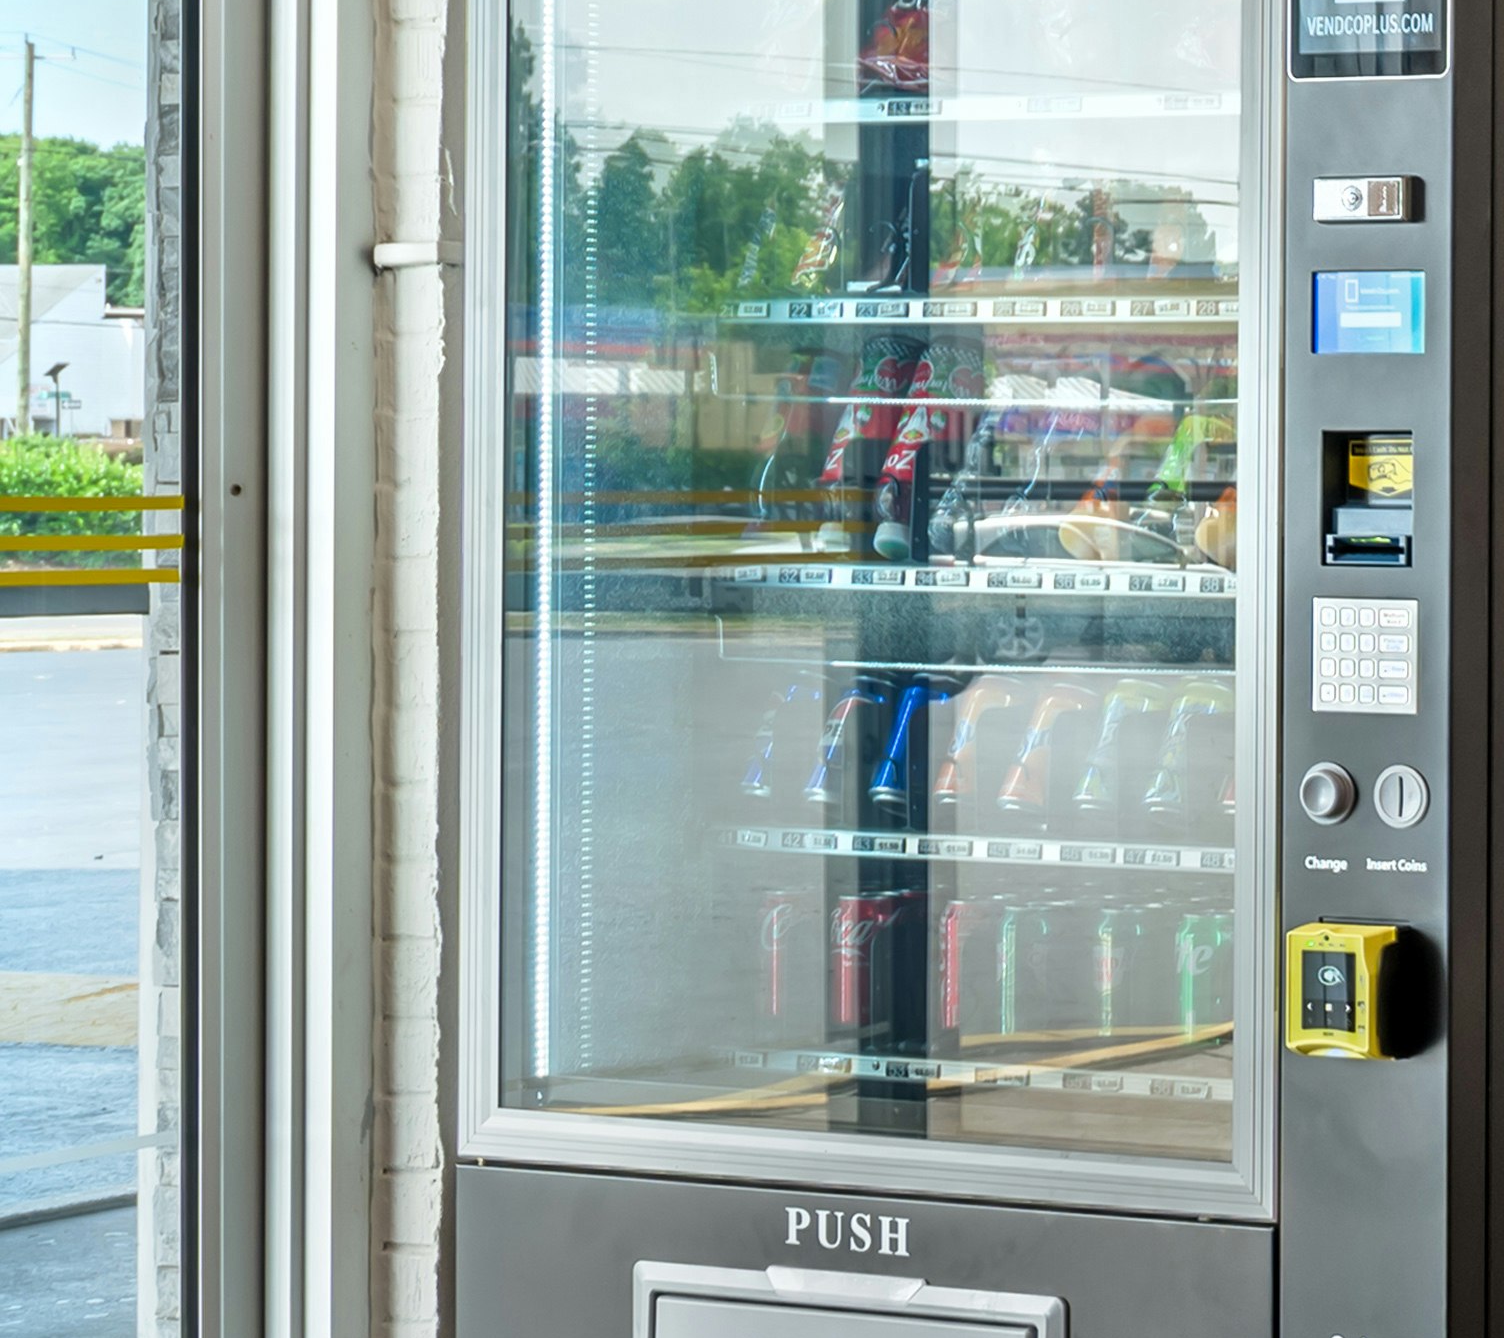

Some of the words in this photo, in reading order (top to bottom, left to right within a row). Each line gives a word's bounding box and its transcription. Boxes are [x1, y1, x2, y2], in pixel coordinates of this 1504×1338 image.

[1306, 13, 1433, 36] VENDCOPLUS.COM
[792, 303, 810, 317] 22
[1132, 302, 1150, 316] 27
[1198, 302, 1216, 315] 28
[781, 567, 800, 582] 32
[854, 570, 873, 584] 33
[1056, 575, 1074, 589] 36
[1130, 577, 1150, 591] 37
[1202, 578, 1220, 592] 38
[783, 833, 802, 847] 42
[1125, 851, 1143, 864] 47
[1203, 853, 1221, 867] 48
[1305, 856, 1348, 873] Change
[1366, 858, 1396, 871] Insert
[1398, 858, 1428, 872] Coins
[784, 1206, 911, 1258] PUSH
